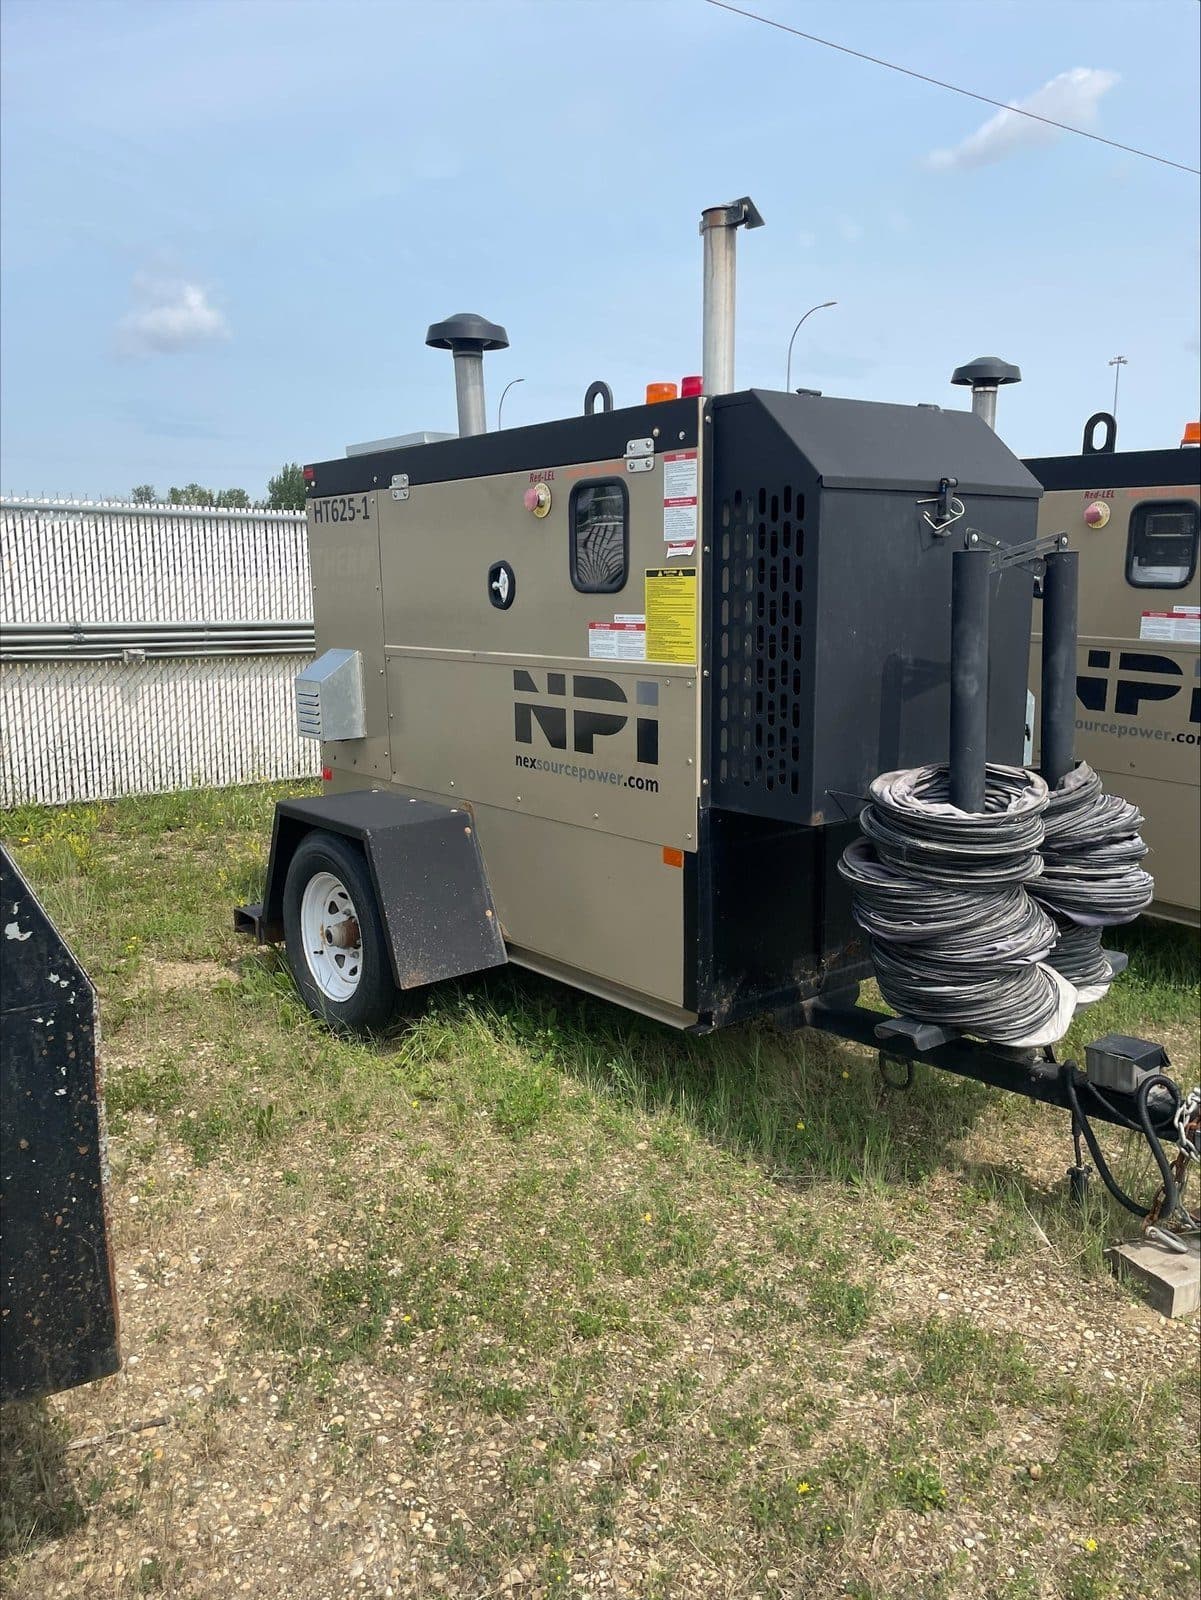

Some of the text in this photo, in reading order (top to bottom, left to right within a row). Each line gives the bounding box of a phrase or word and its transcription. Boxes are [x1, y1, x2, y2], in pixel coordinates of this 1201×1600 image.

[529, 470, 555, 482] Red-LEL
[1083, 490, 1115, 499] Red-LEL
[313, 496, 370, 524] HT625-1
[515, 754, 659, 793] nexsourcepower.com
